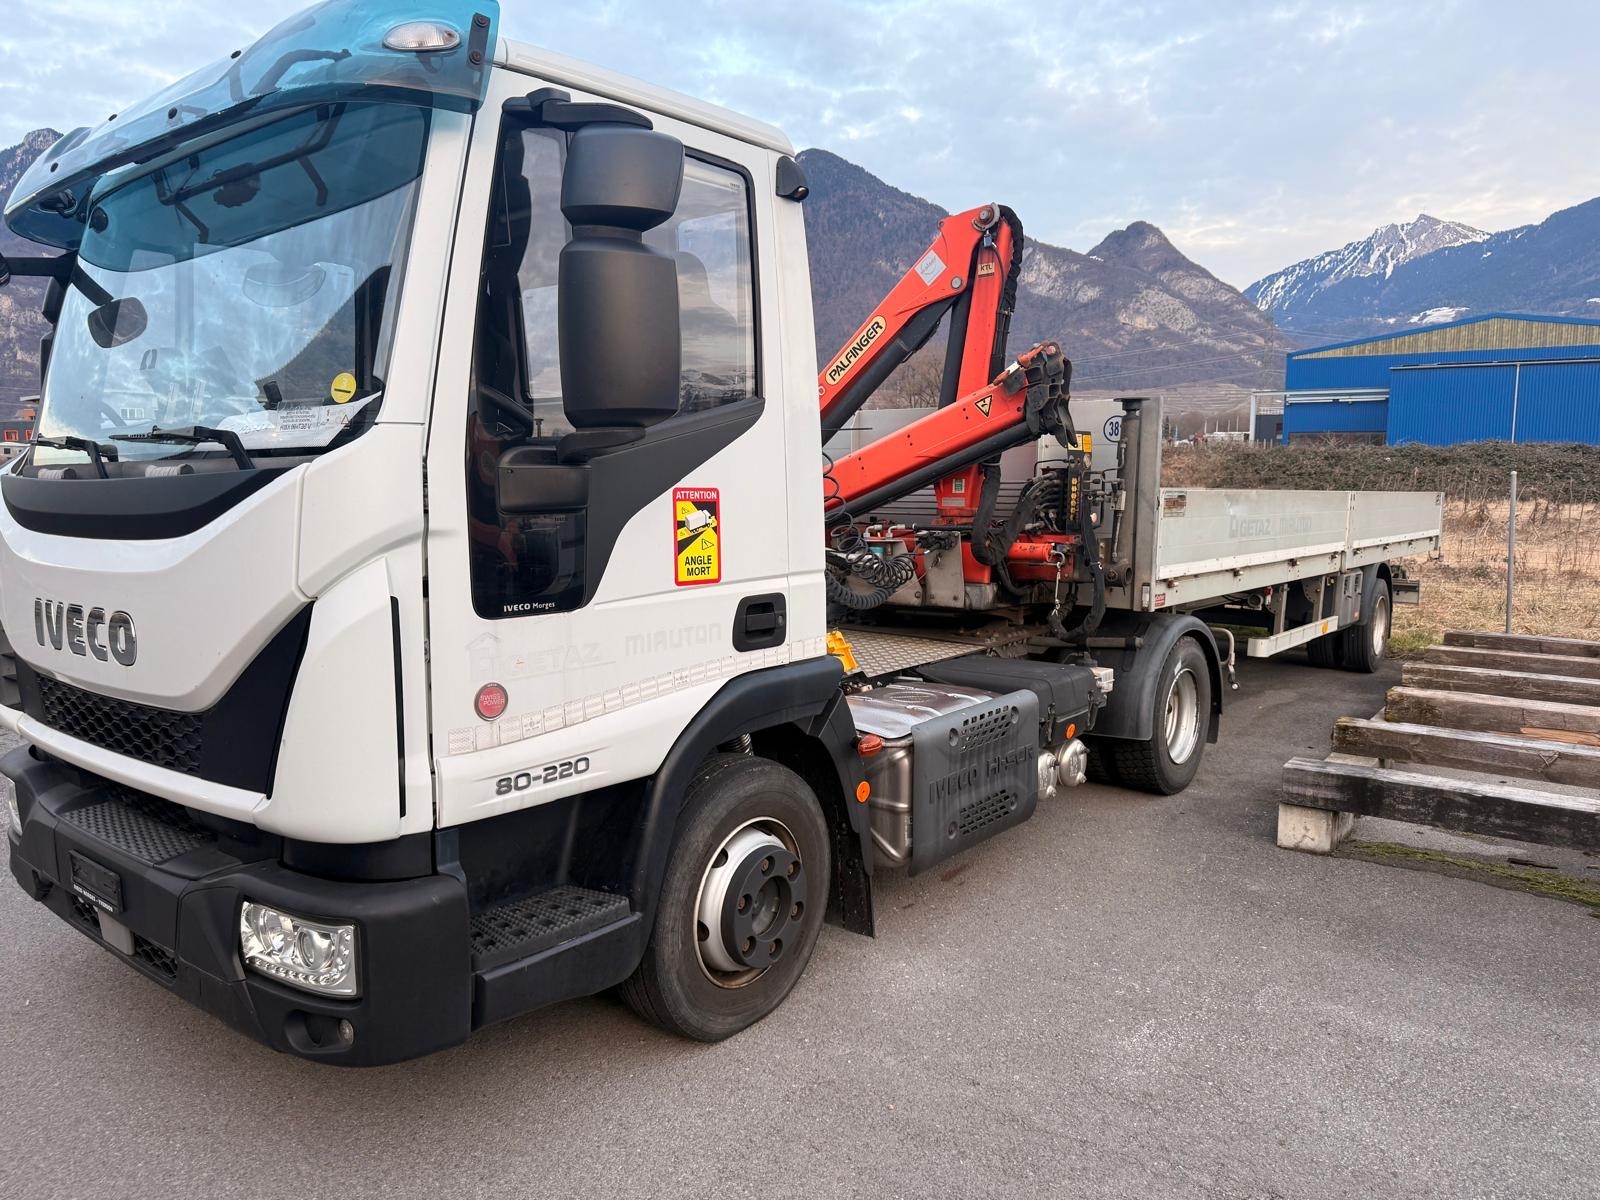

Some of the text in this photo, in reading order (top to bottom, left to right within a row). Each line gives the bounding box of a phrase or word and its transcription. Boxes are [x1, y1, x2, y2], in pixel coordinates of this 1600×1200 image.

[980, 264, 993, 272] KTL
[828, 321, 883, 382] PALFINGER
[676, 490, 717, 499] ATTENTION
[684, 555, 712, 566] ANGLE
[686, 566, 711, 576] MORT
[503, 602, 555, 612] IVECO Morges
[34, 597, 138, 666] IVECO
[480, 693, 501, 701] SWISS
[483, 698, 505, 706] POWER
[495, 756, 589, 796] 80-220
[928, 763, 977, 805] IVECO
